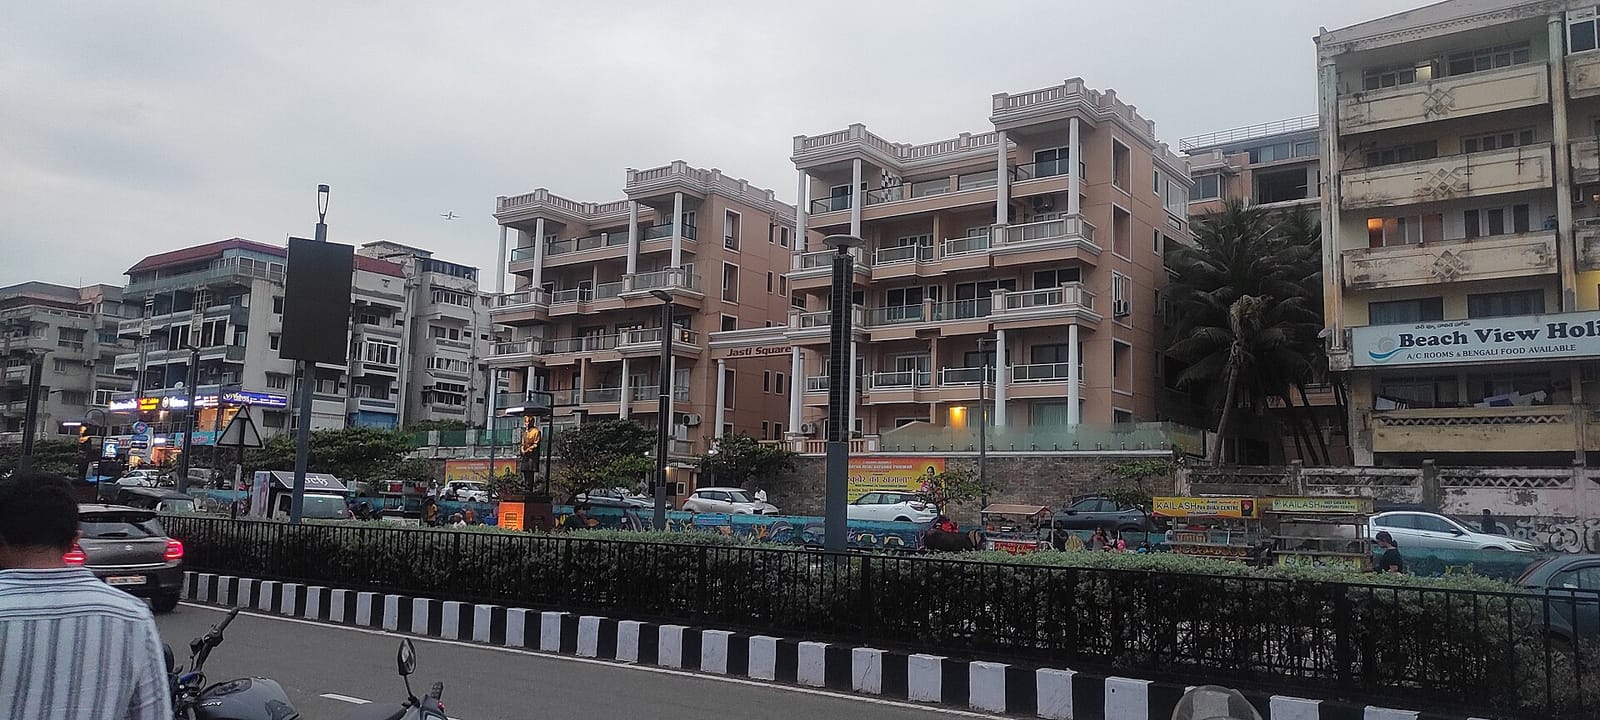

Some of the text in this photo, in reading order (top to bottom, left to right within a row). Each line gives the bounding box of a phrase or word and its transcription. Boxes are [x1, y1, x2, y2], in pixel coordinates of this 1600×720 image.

[1399, 331, 1468, 348] Beach
[1474, 328, 1540, 343] View
[727, 346, 791, 357] Jasti Square
[1462, 349, 1498, 357] BENGALI
[1501, 347, 1526, 355] FOOD
[1529, 344, 1576, 353] AVAILABLE
[1157, 502, 1197, 510] KAILASH
[1282, 501, 1320, 509] KAILASH
